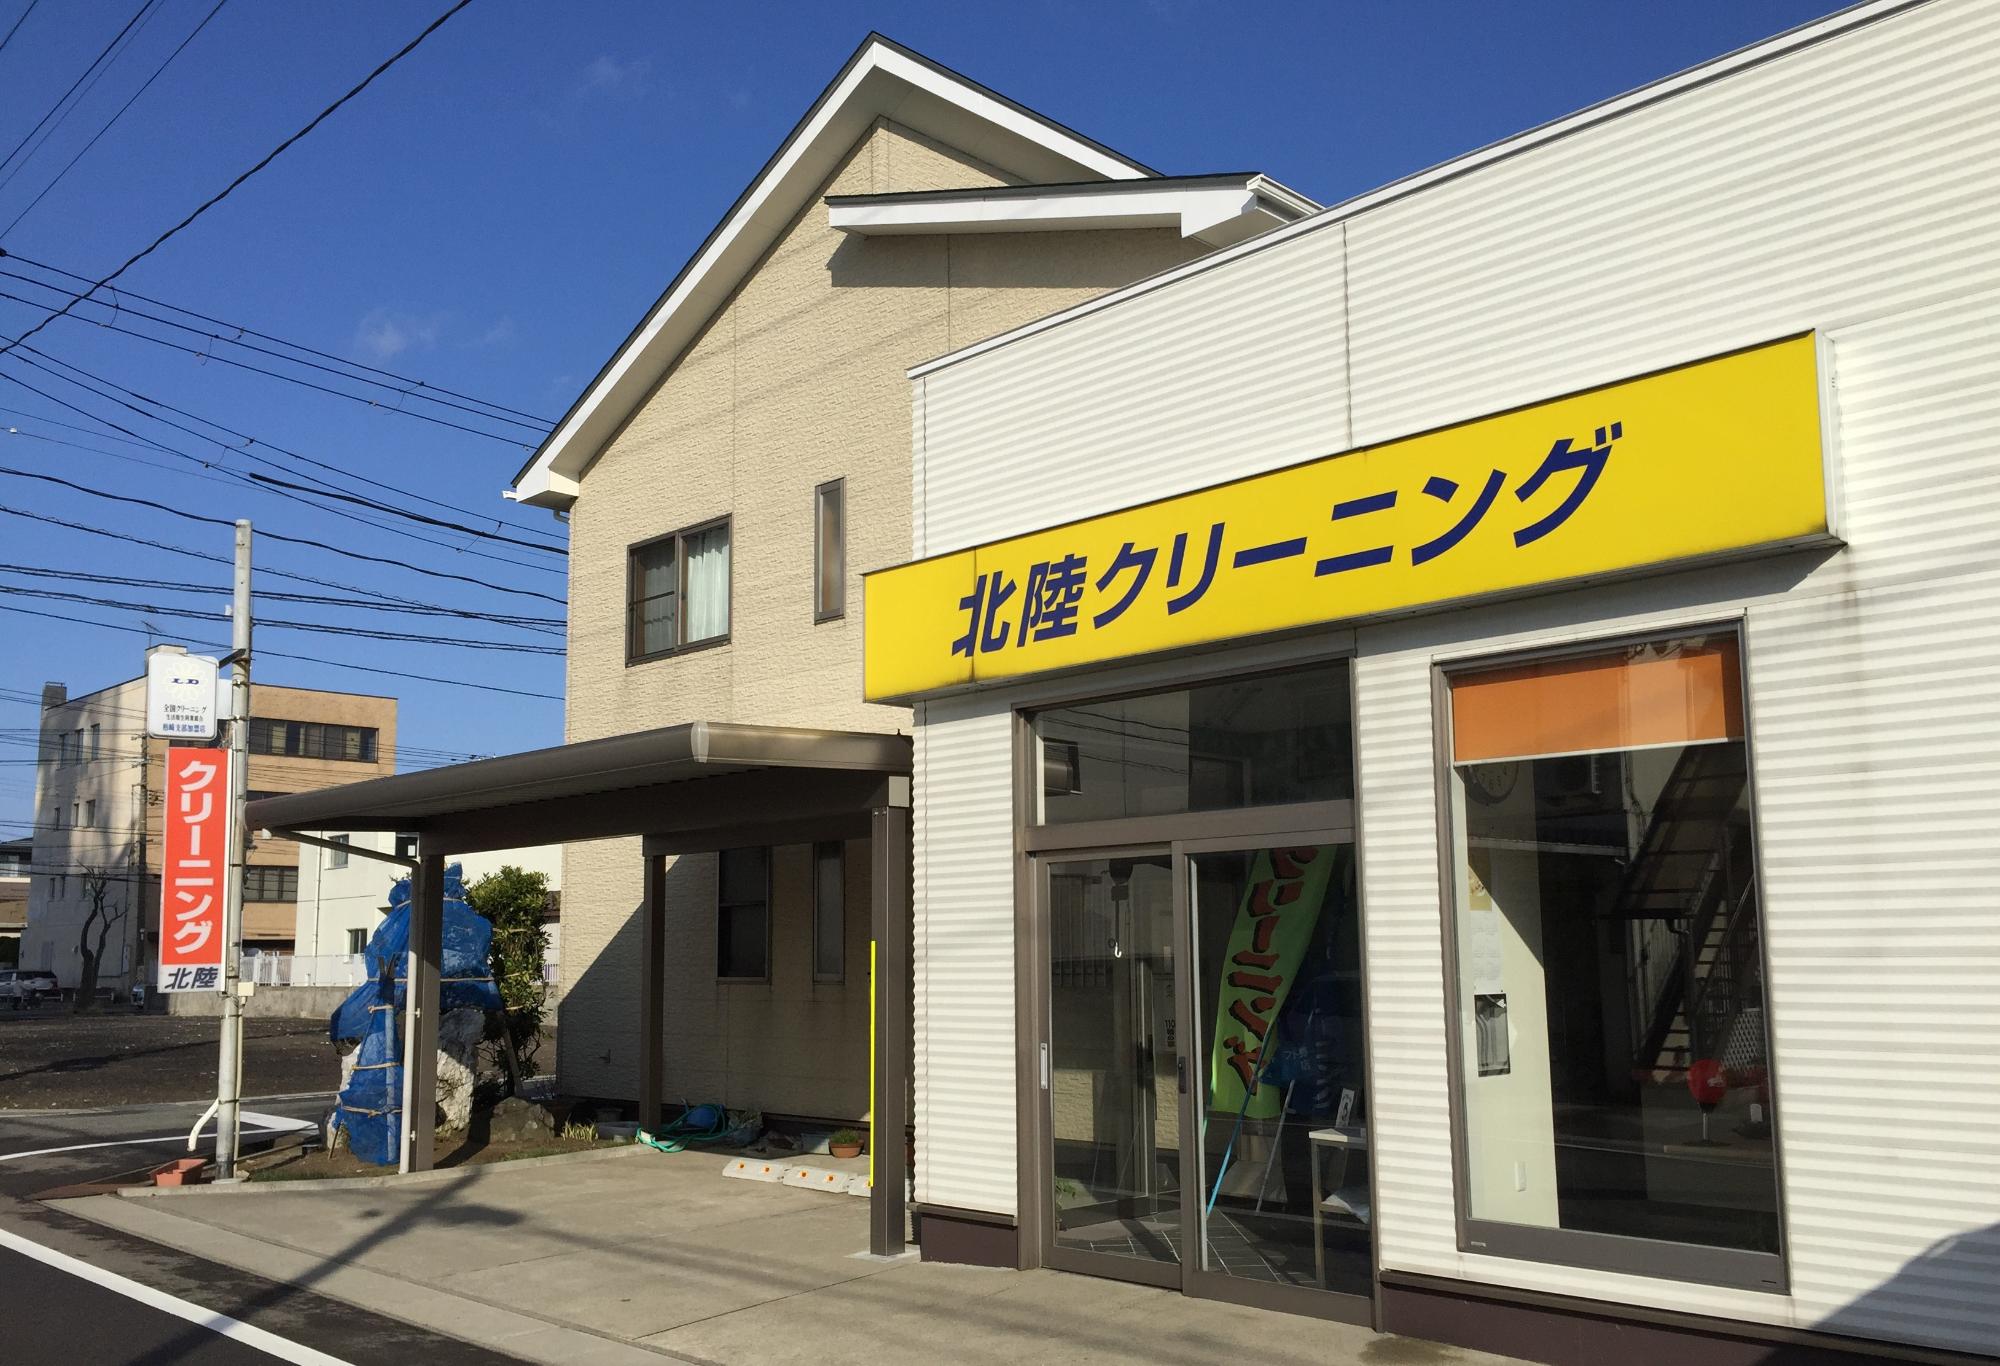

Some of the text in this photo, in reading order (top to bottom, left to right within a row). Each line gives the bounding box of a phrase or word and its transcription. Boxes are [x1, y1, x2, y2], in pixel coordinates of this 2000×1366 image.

[952, 421, 1622, 658] 北陸クリーニング
[163, 704, 207, 713] 全国クリーニング
[173, 760, 217, 955] クリーニング
[164, 967, 219, 991] 北陸
